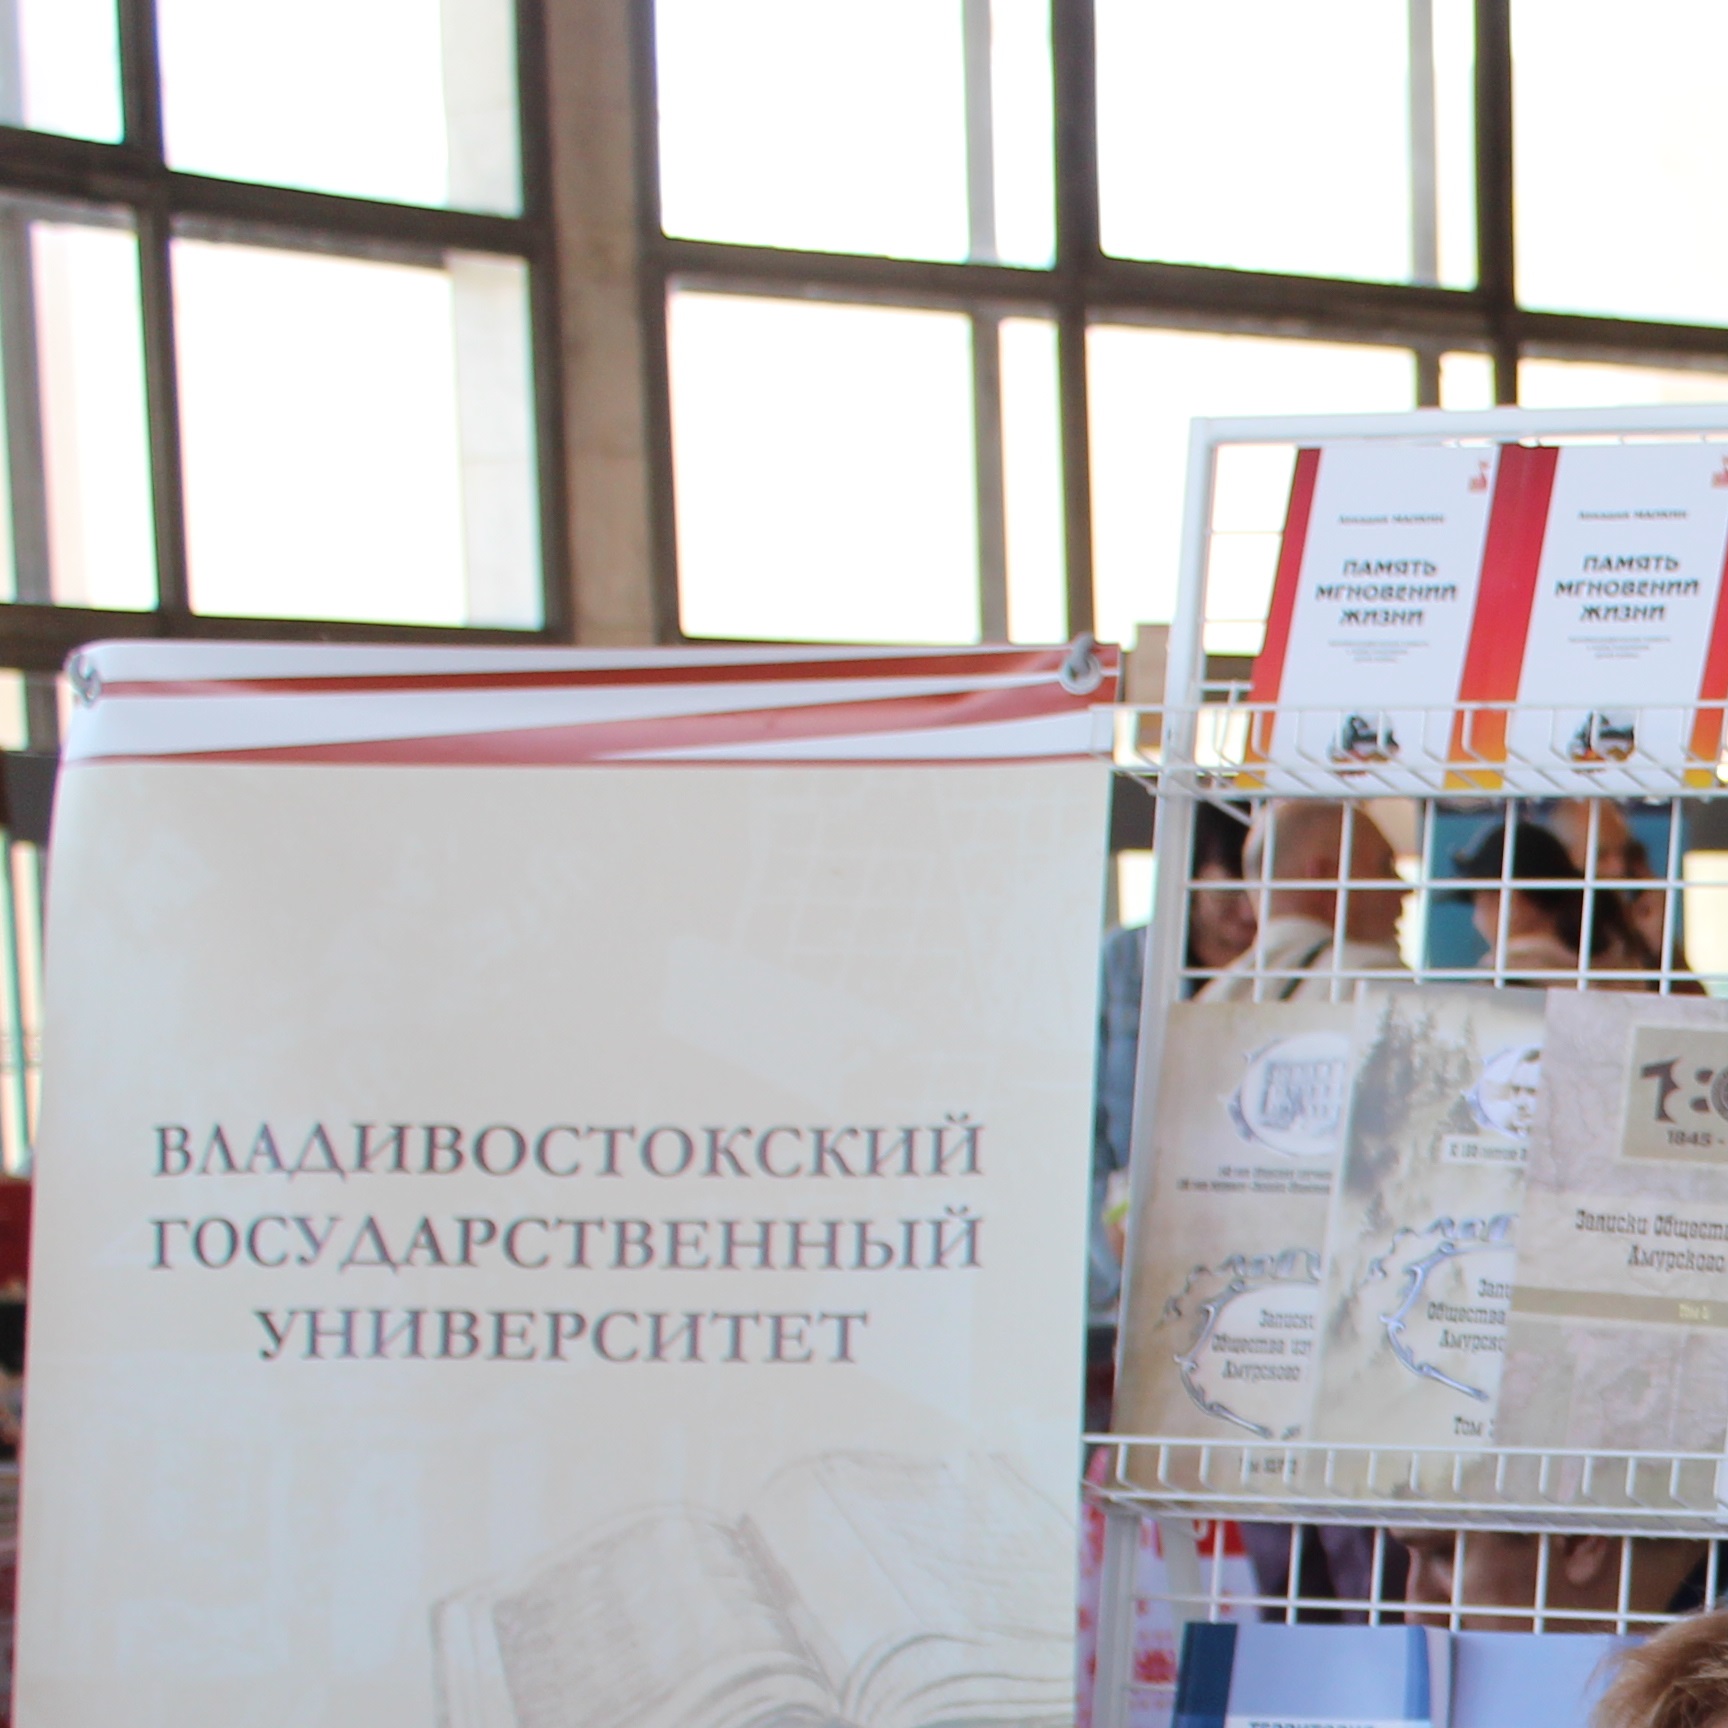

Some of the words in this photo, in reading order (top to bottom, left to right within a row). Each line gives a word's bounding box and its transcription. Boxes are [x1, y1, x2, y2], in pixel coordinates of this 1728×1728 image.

[152, 1114, 985, 1184] ВЛАДИВОСТОКСКИЙ
[149, 1206, 984, 1276] ГОСУДАРСТВЕННЫЙ
[253, 1308, 870, 1364] УНИВЕРСИТЕТ
